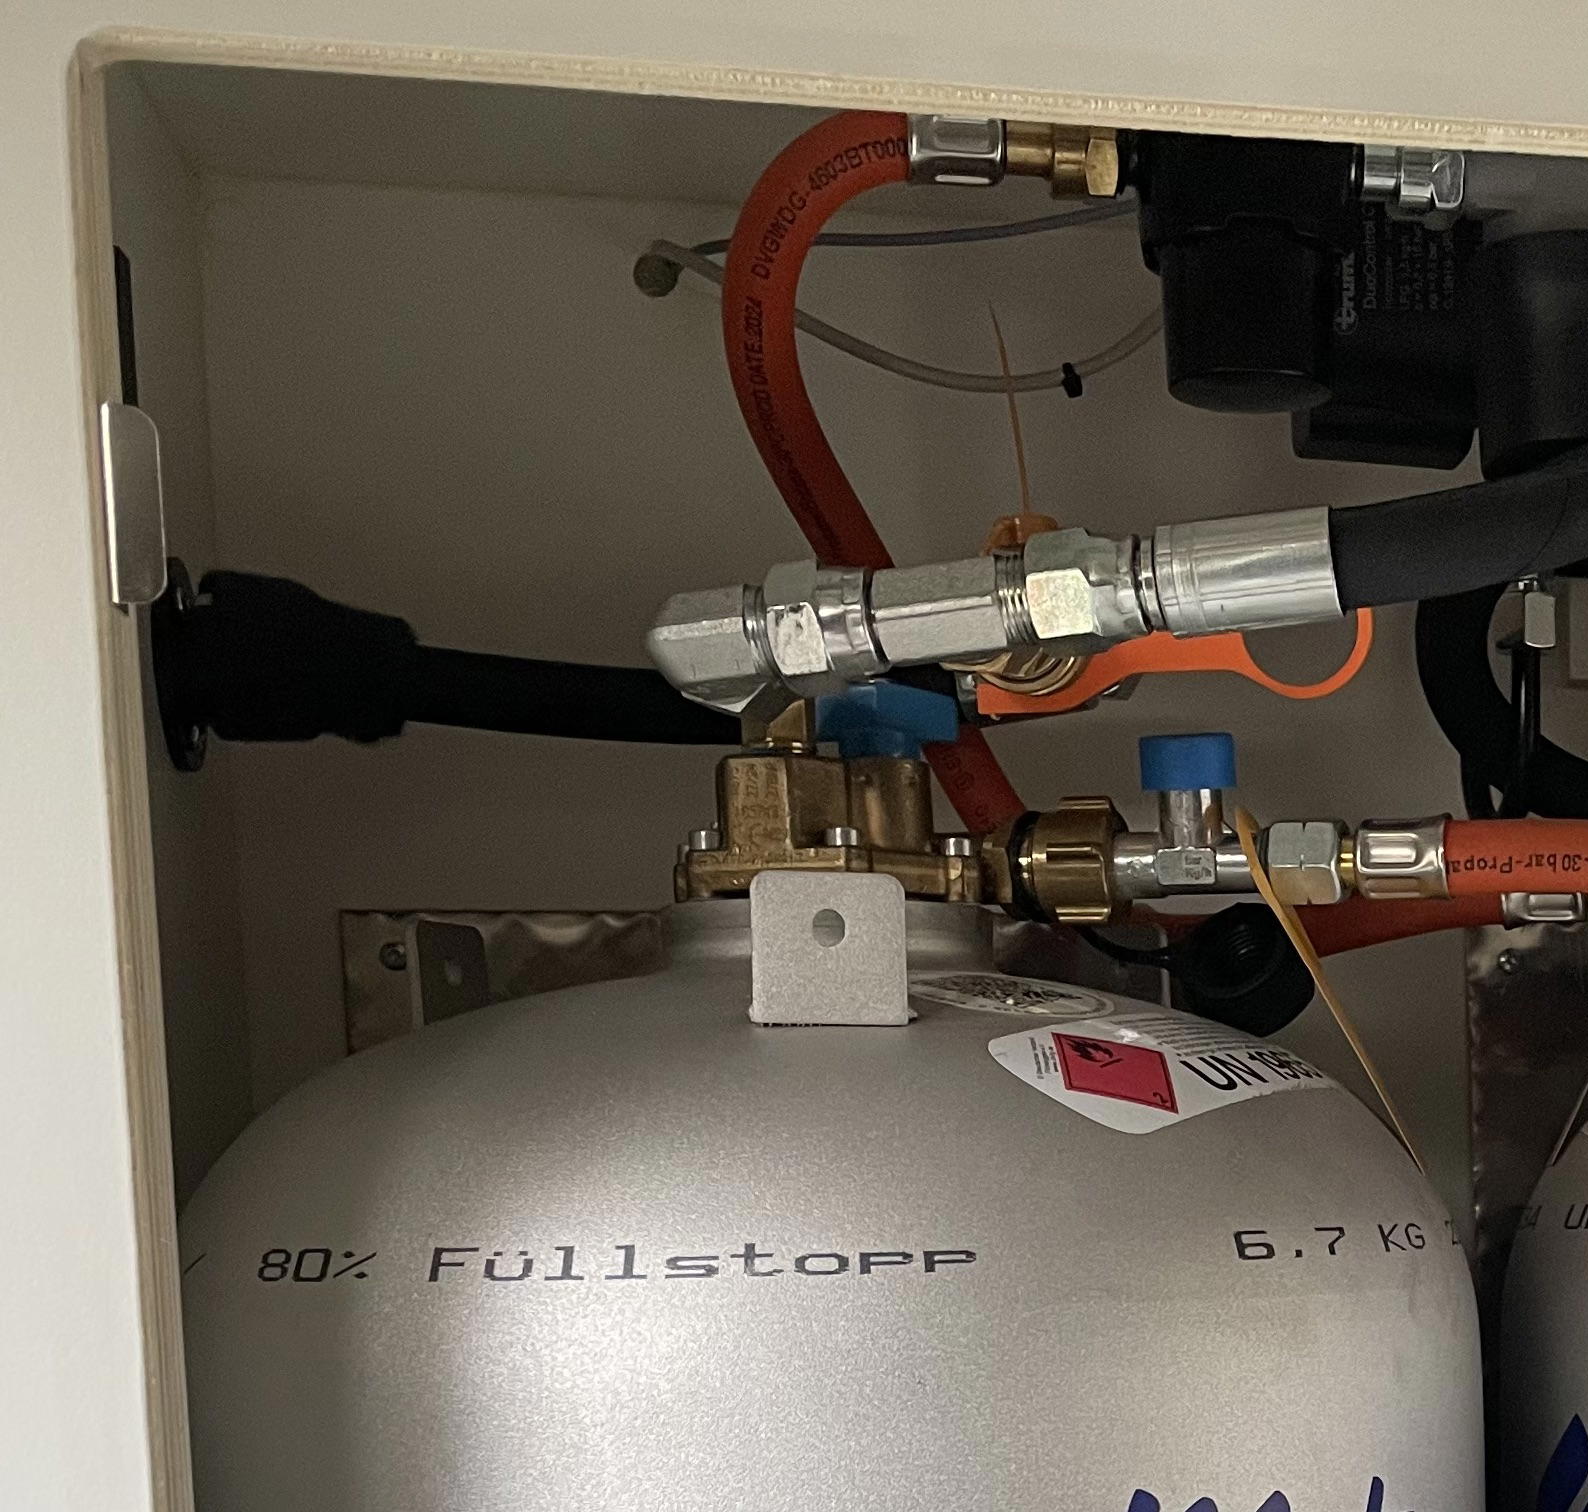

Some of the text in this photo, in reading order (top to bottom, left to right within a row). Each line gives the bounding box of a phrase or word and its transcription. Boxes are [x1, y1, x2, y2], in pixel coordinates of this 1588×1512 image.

[750, 136, 909, 280] DVGWDG-4603BT000
[1179, 1053, 1268, 1092] UN
[257, 1247, 377, 1283] 80%
[428, 1241, 979, 1284] Füllstopp
[1377, 1222, 1426, 1253] KG
